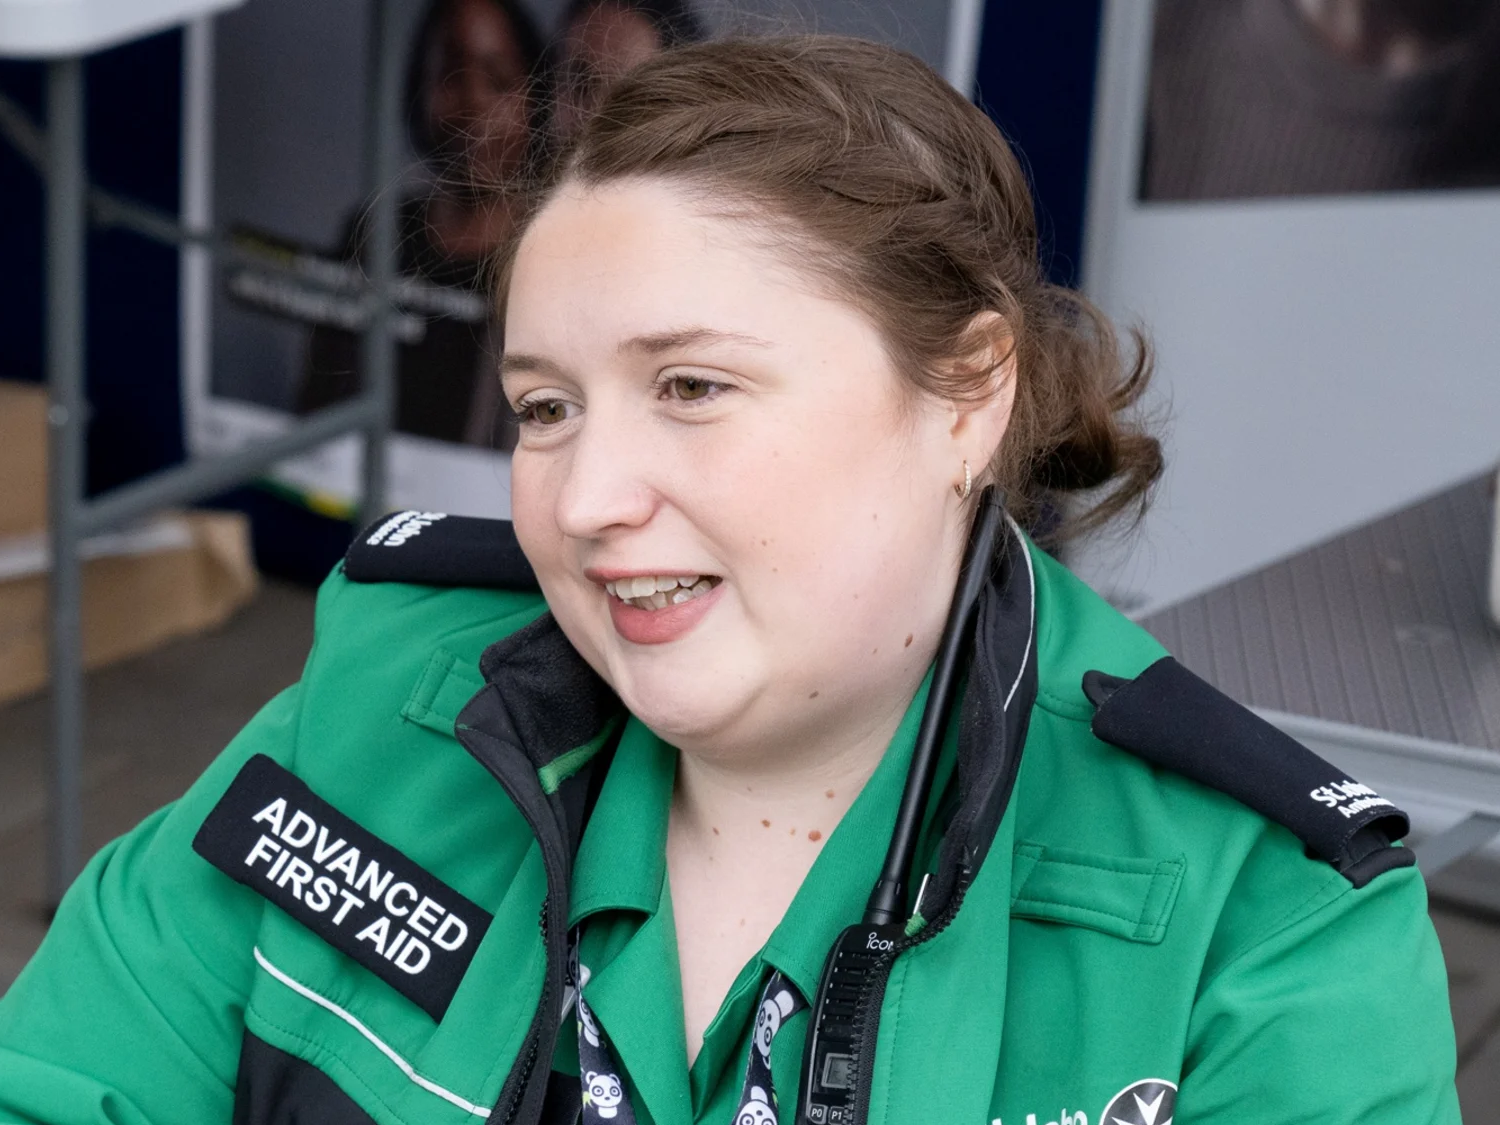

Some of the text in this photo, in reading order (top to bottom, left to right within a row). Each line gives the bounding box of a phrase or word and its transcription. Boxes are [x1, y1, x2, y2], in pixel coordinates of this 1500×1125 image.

[244, 834, 432, 976] FIRST AID
[251, 797, 469, 952] ADVANCED
[831, 1110, 843, 1122] P1
